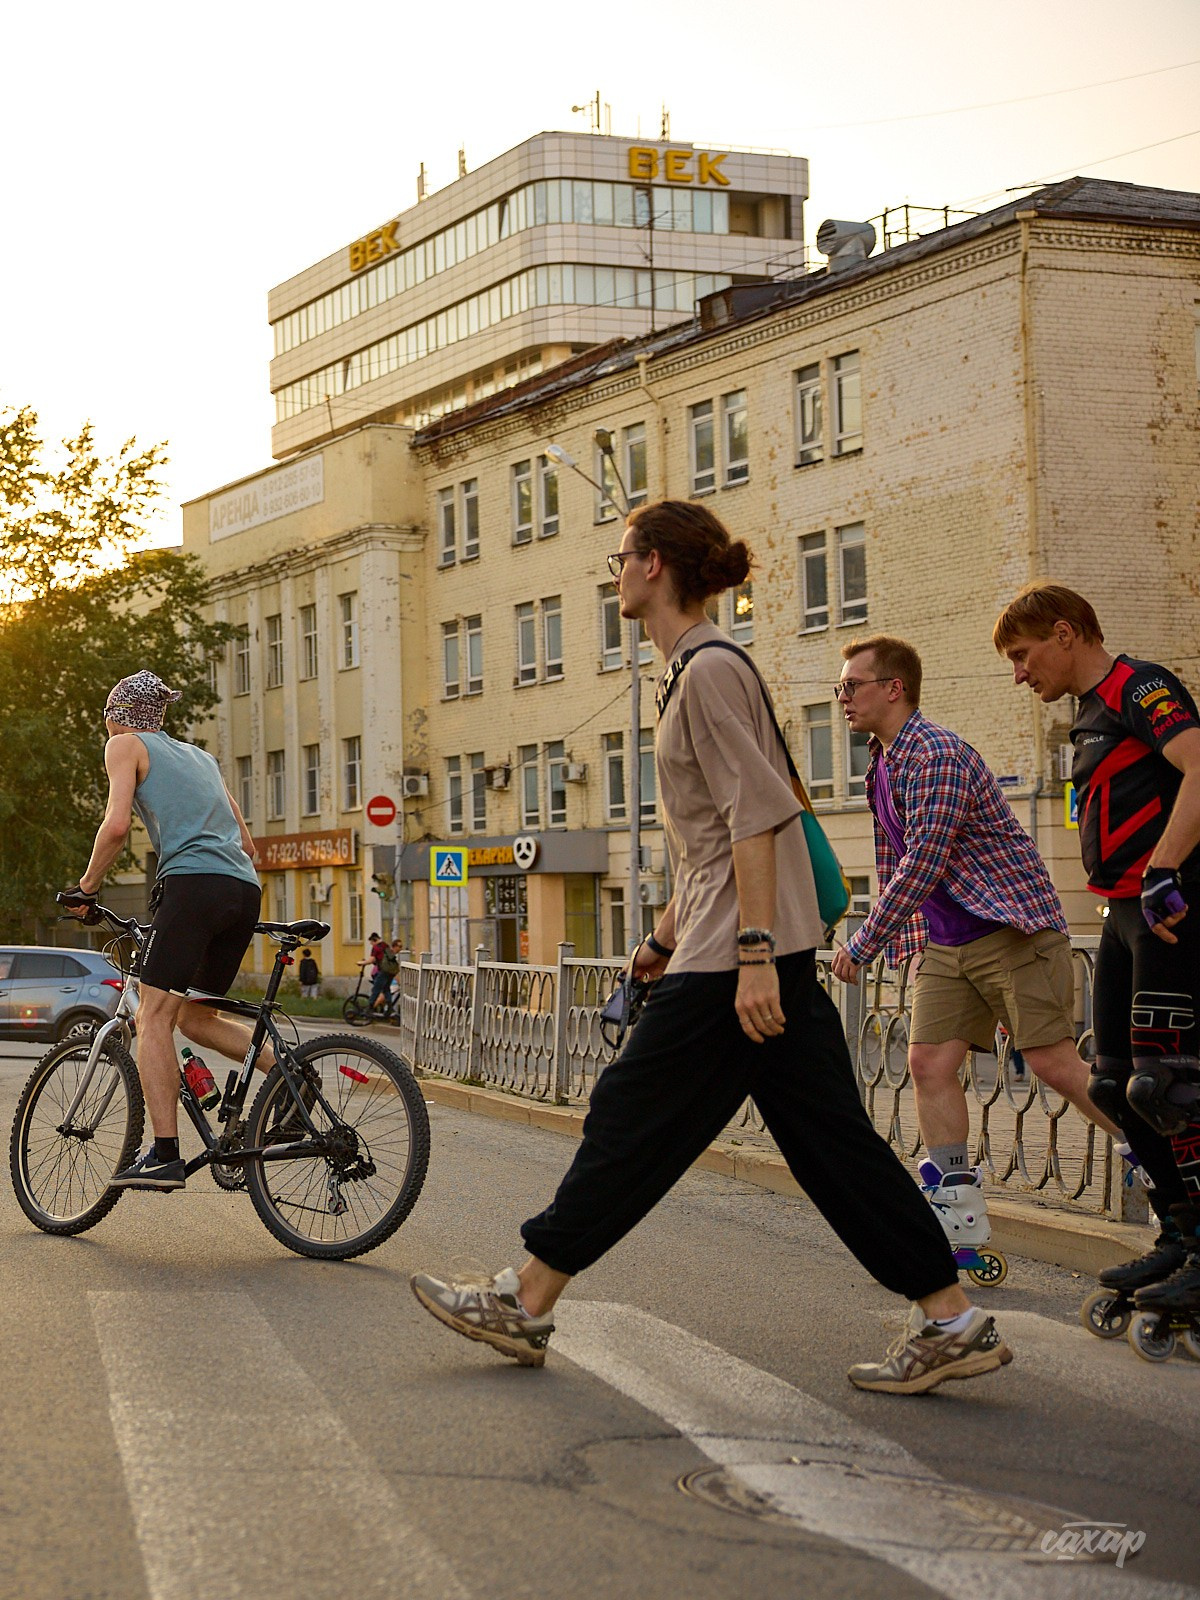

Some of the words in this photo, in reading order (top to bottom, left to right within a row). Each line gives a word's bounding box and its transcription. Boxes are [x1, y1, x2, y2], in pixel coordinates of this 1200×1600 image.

[628, 146, 731, 186] ВЕК
[350, 221, 401, 272] ВЕК
[212, 490, 260, 531] АРЕНДА
[1132, 678, 1168, 703] citrix
[1152, 716, 1174, 738] Red
[1083, 735, 1104, 745] ORACLE
[468, 846, 514, 867] ЕКАРНЯ
